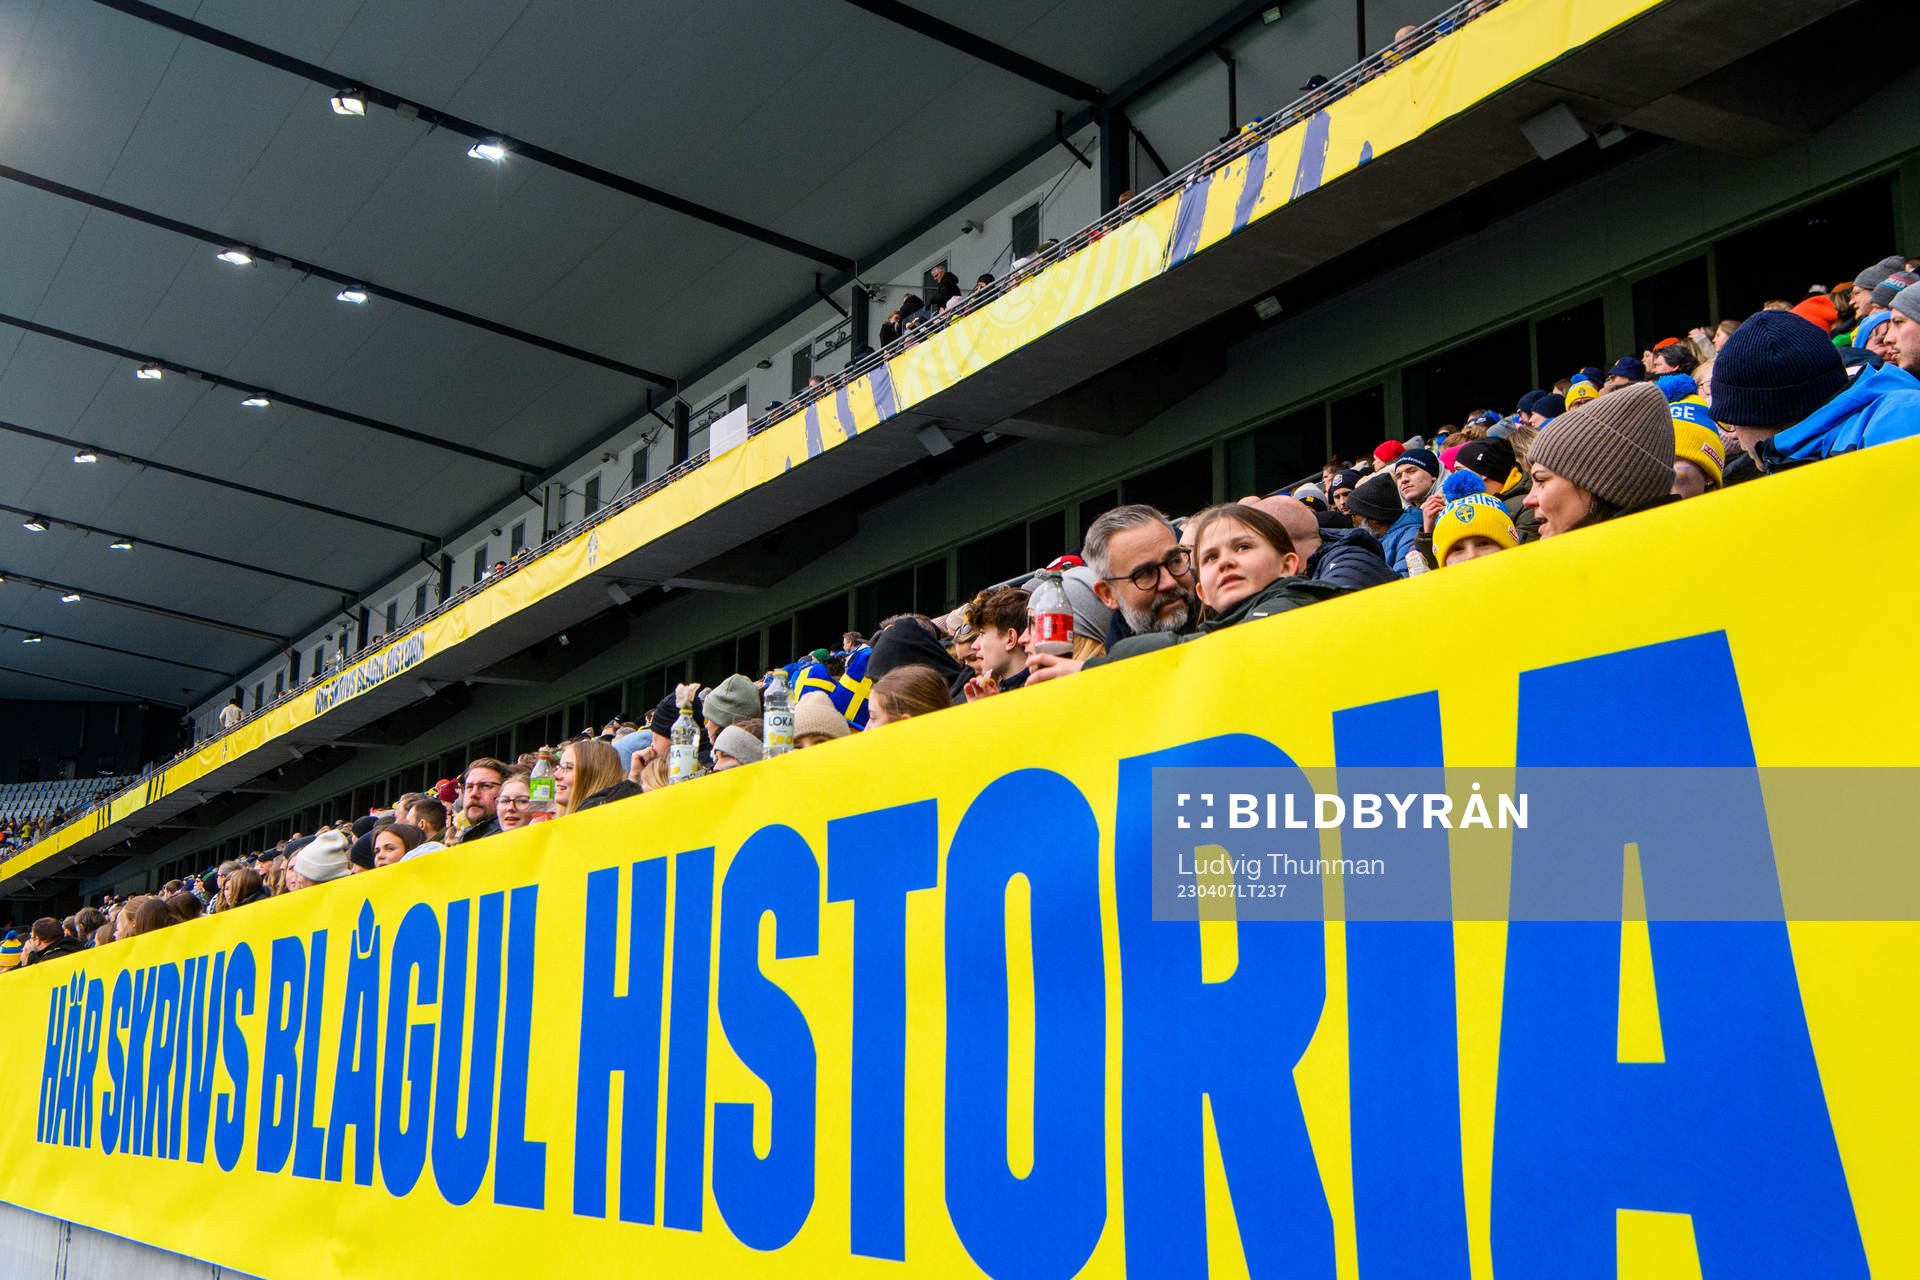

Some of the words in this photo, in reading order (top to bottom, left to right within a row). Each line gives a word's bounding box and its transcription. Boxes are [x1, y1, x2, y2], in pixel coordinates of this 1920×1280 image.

[768, 715, 793, 727] LOKA
[36, 967, 104, 1149] HÄR
[100, 941, 258, 1173] SKRIVS
[256, 884, 548, 1212] BLÅGUL
[573, 630, 1871, 1280] HISTORIA
